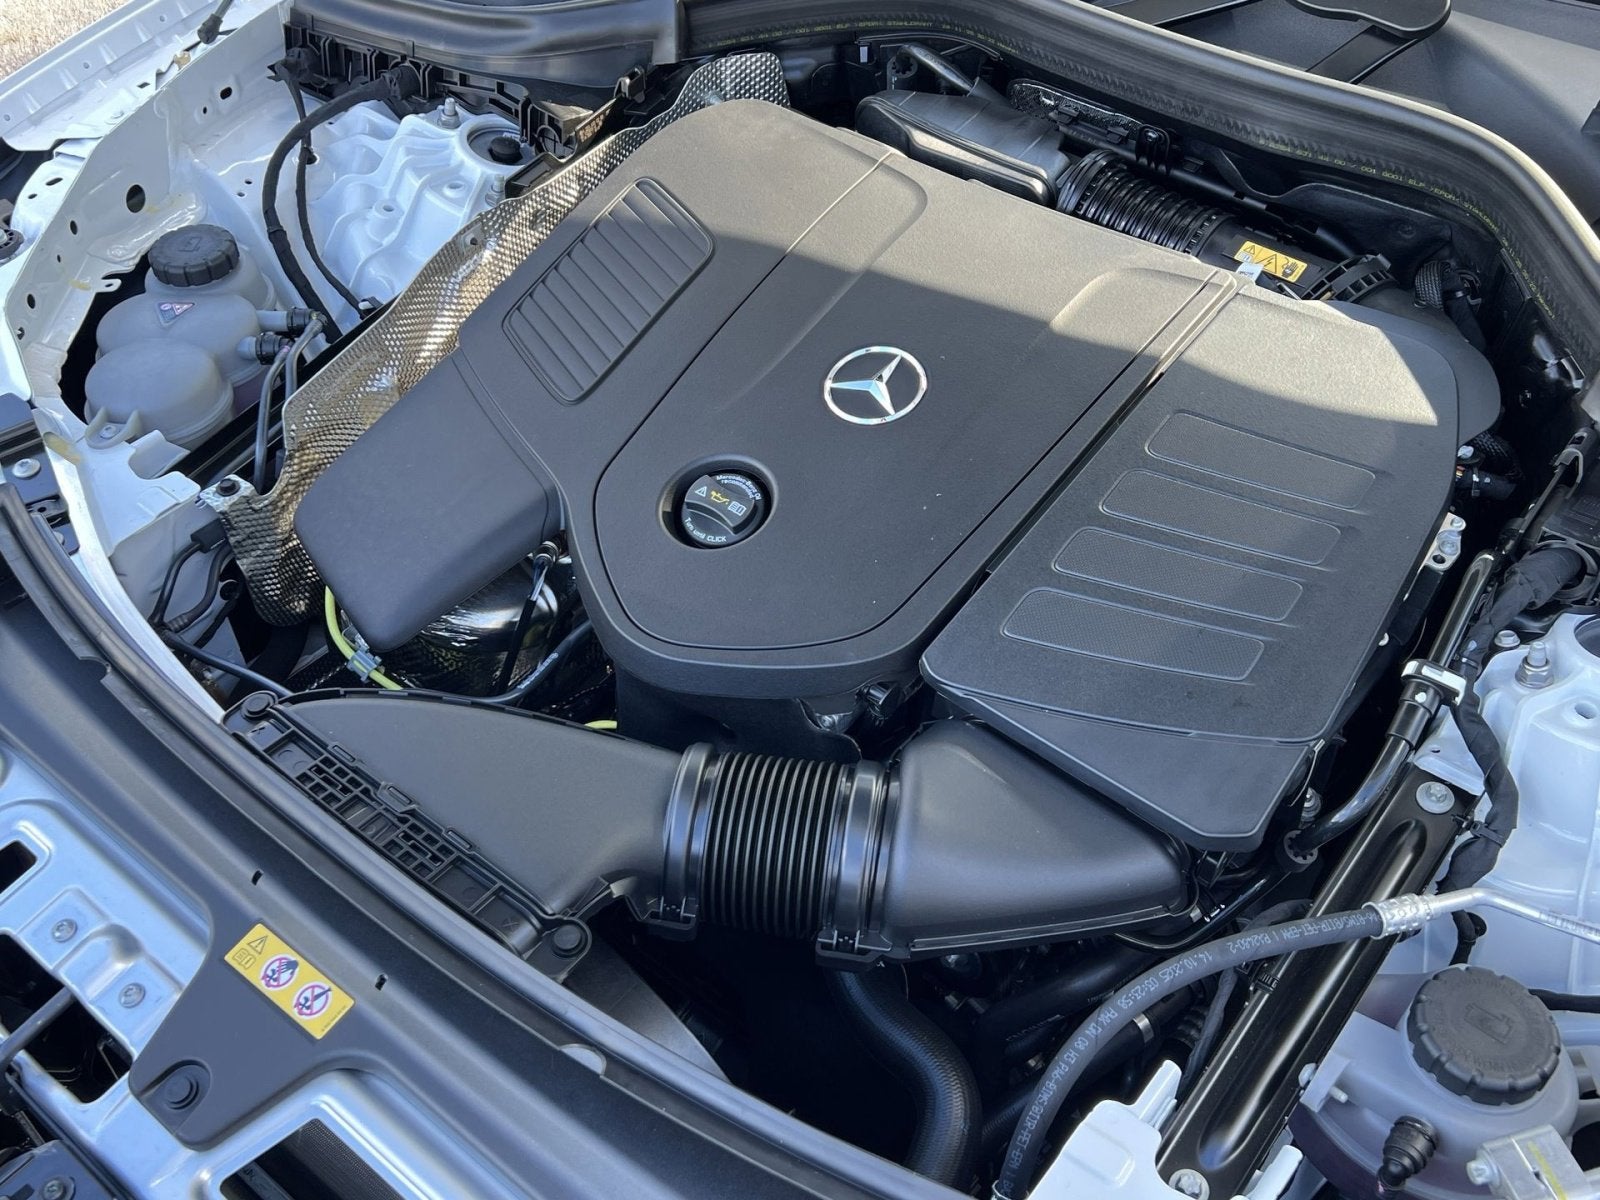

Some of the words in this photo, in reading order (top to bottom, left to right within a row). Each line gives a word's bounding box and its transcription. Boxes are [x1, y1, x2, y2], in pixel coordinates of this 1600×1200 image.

[1334, 158, 1346, 166] 00
[1360, 166, 1377, 175] 001
[1408, 178, 1426, 188] ELP
[716, 475, 758, 493] Mercedes-Benz
[721, 479, 755, 499] recommended
[684, 517, 694, 530] Turn
[693, 529, 706, 539] until
[1159, 951, 1213, 981] 14.10.2025
[1118, 977, 1160, 1009] 03:23:58
